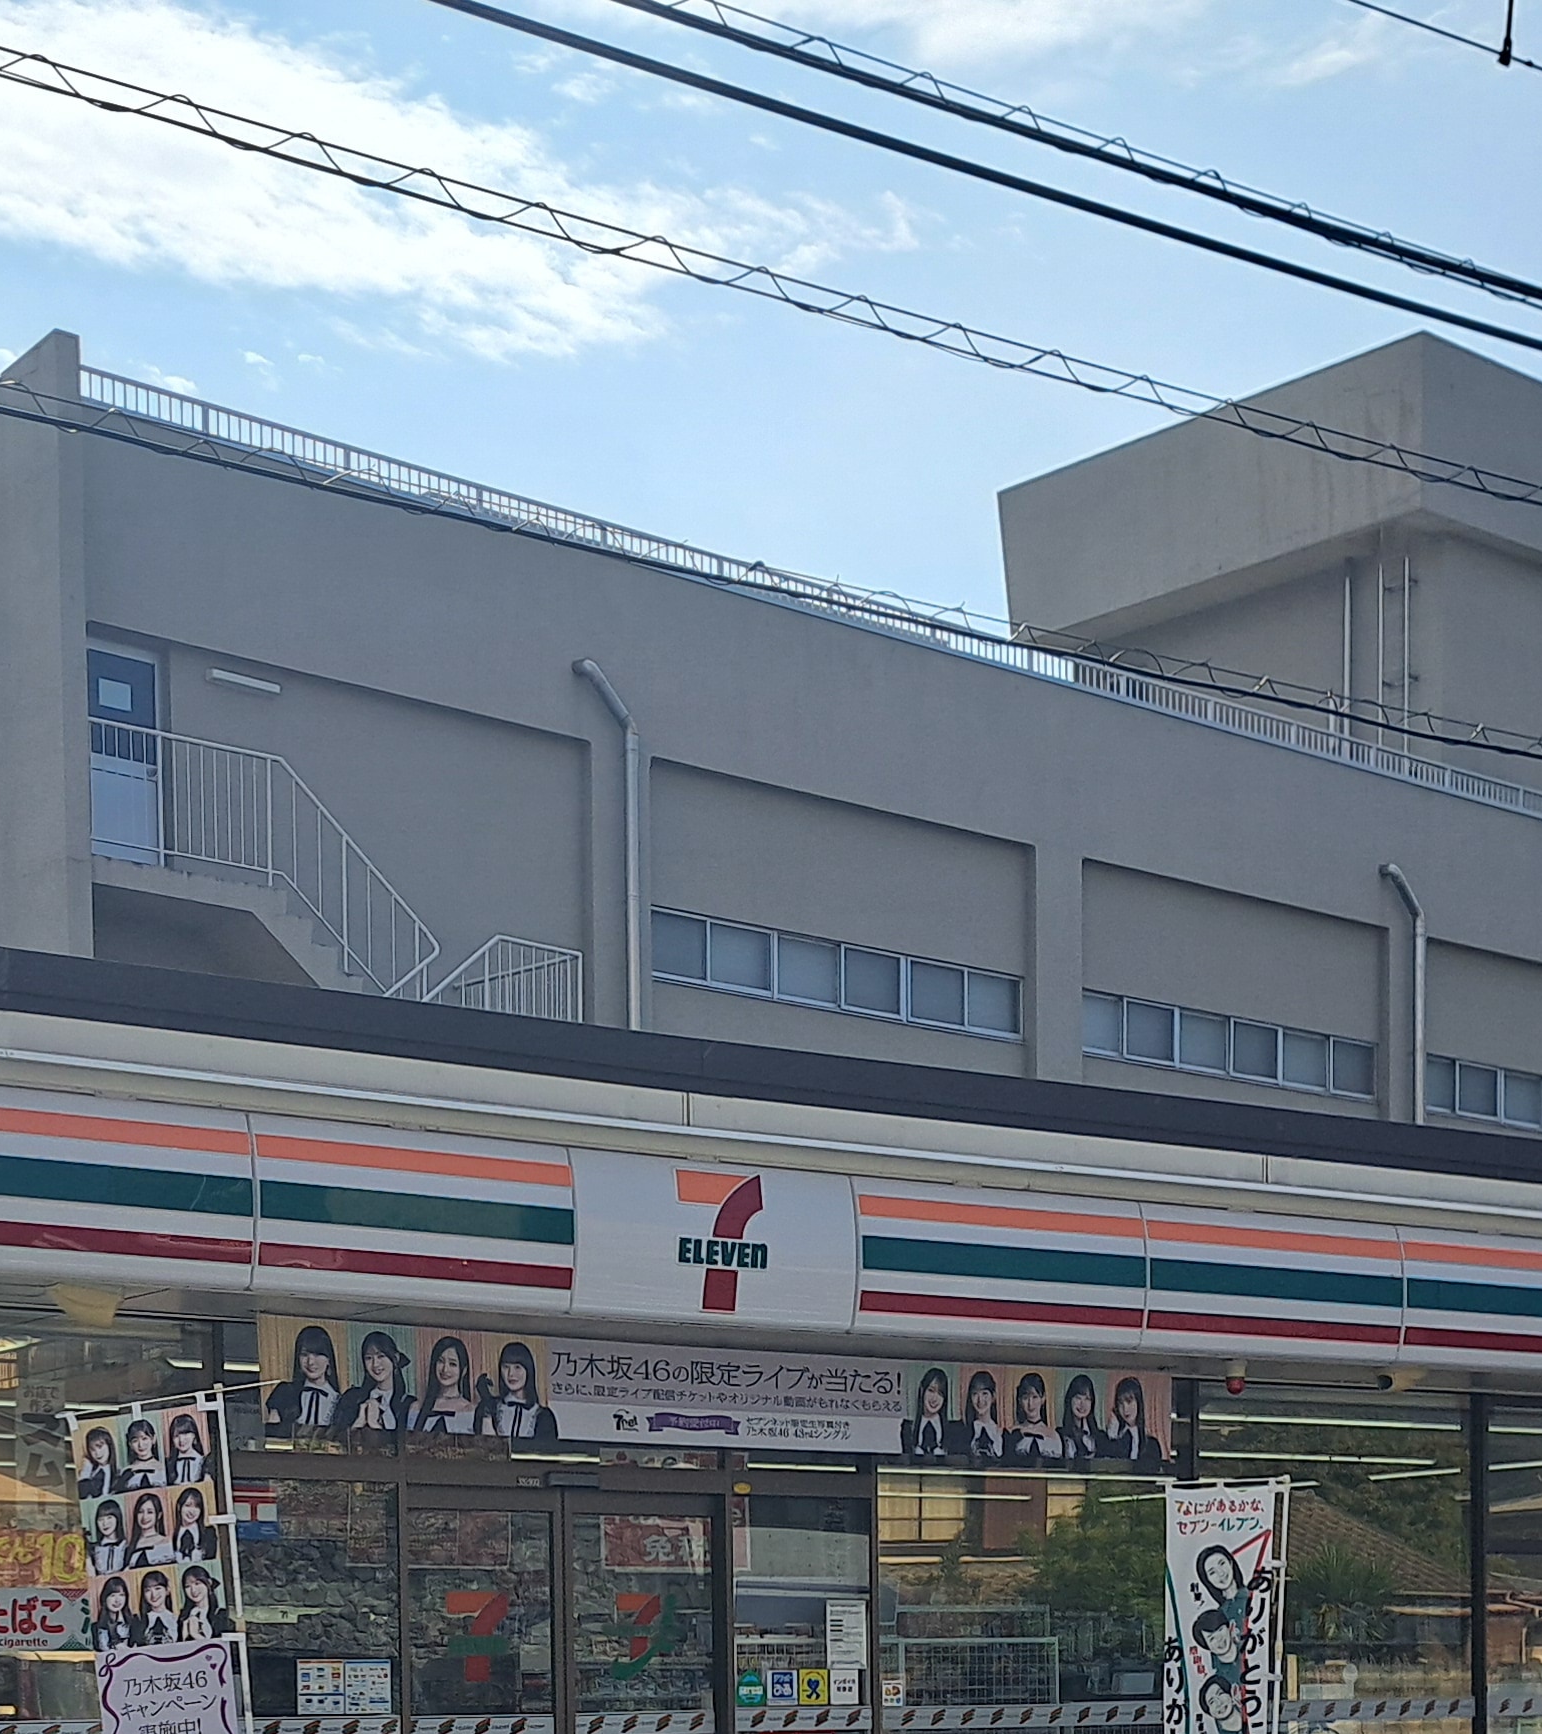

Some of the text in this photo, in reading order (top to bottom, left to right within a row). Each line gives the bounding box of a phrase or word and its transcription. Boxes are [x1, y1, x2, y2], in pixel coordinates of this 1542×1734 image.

[676, 1170, 763, 1310] 7
[124, 1670, 208, 1698] 乃木坂46
[120, 1695, 218, 1721] キャンペーン
